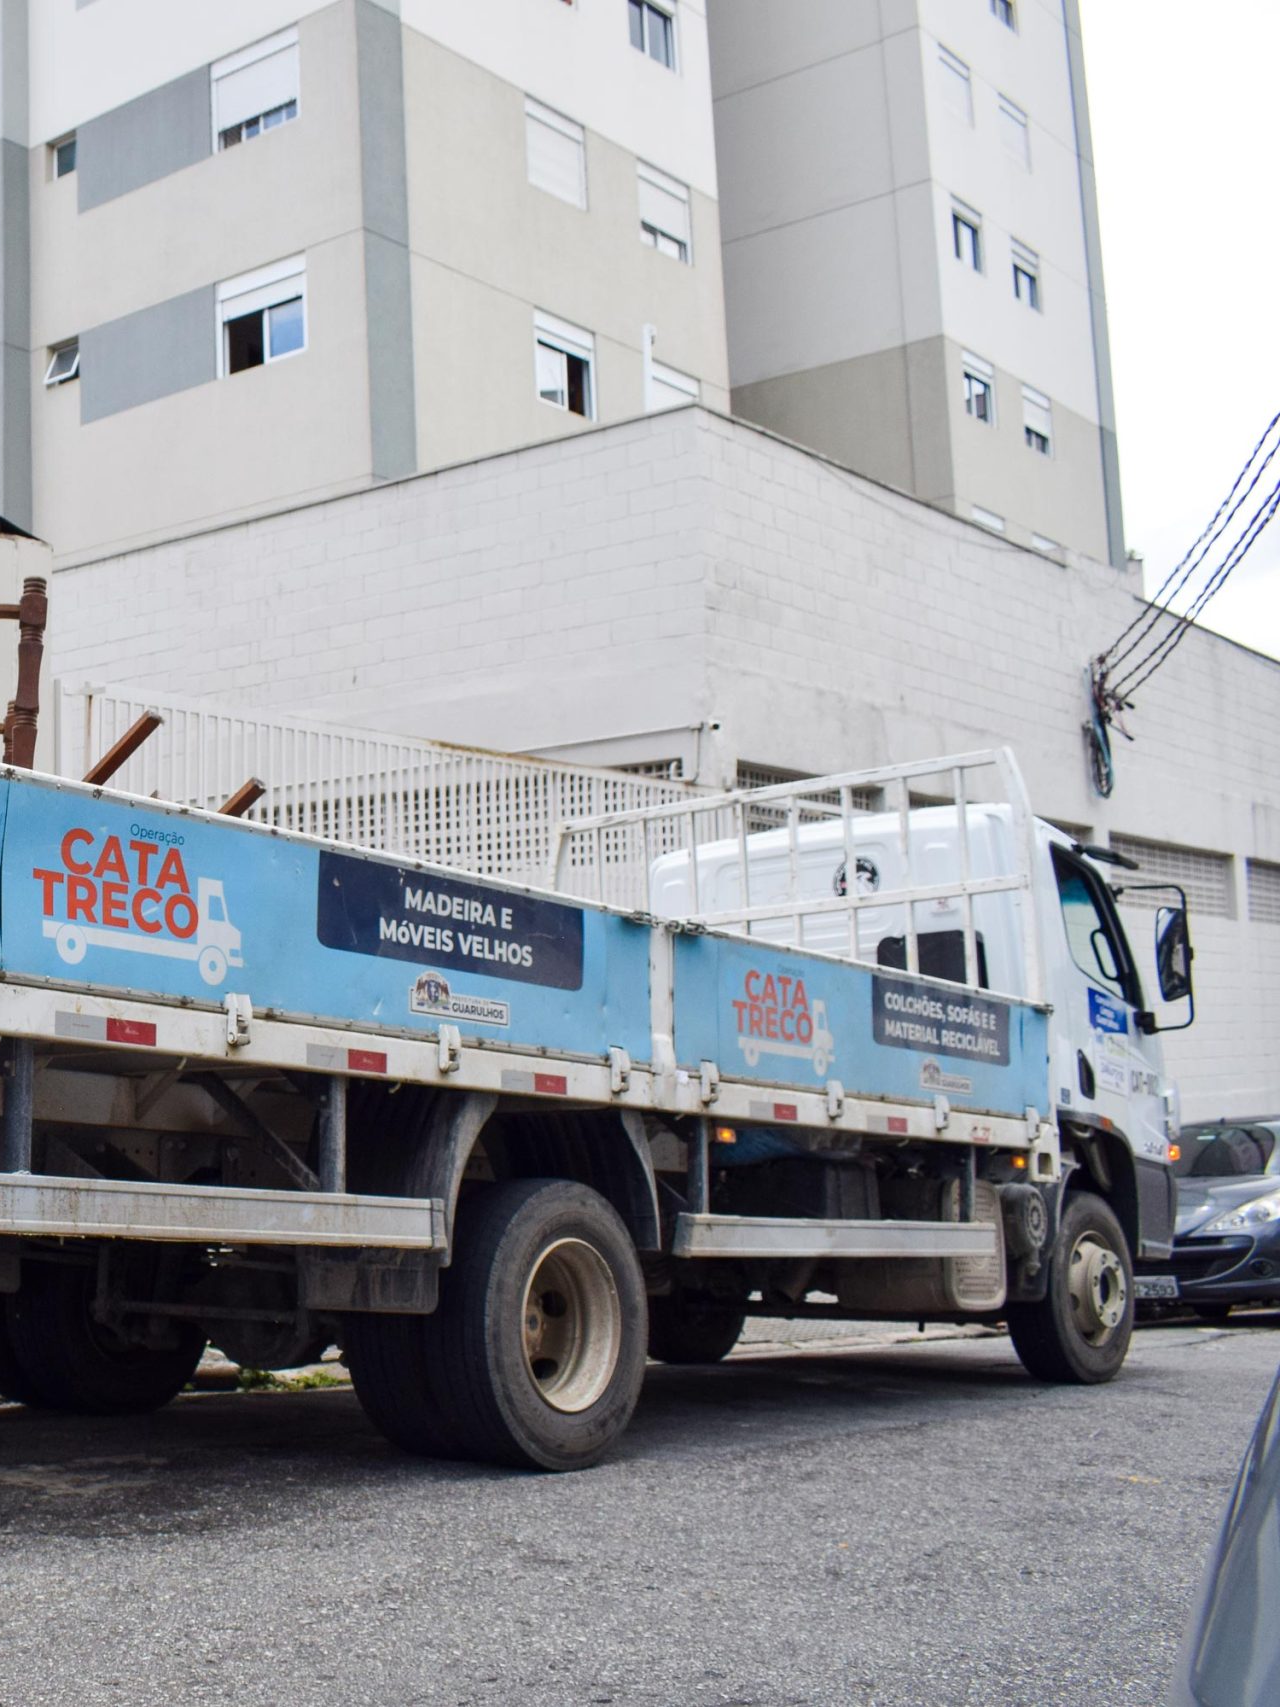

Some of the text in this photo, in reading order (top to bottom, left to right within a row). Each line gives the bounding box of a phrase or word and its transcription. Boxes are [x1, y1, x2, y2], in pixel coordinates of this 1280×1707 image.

[130, 824, 185, 847] Operação
[60, 828, 190, 894] CATA
[32, 868, 199, 939] TRECO
[404, 886, 513, 930] MADEIRA E
[457, 932, 533, 967] VELHOS
[451, 1002, 505, 1019] GUARULHOS
[744, 969, 809, 1012] CATA
[732, 1000, 814, 1044] TRECO
[884, 1019, 1000, 1056] MATERIAL RECICLÁVEL
